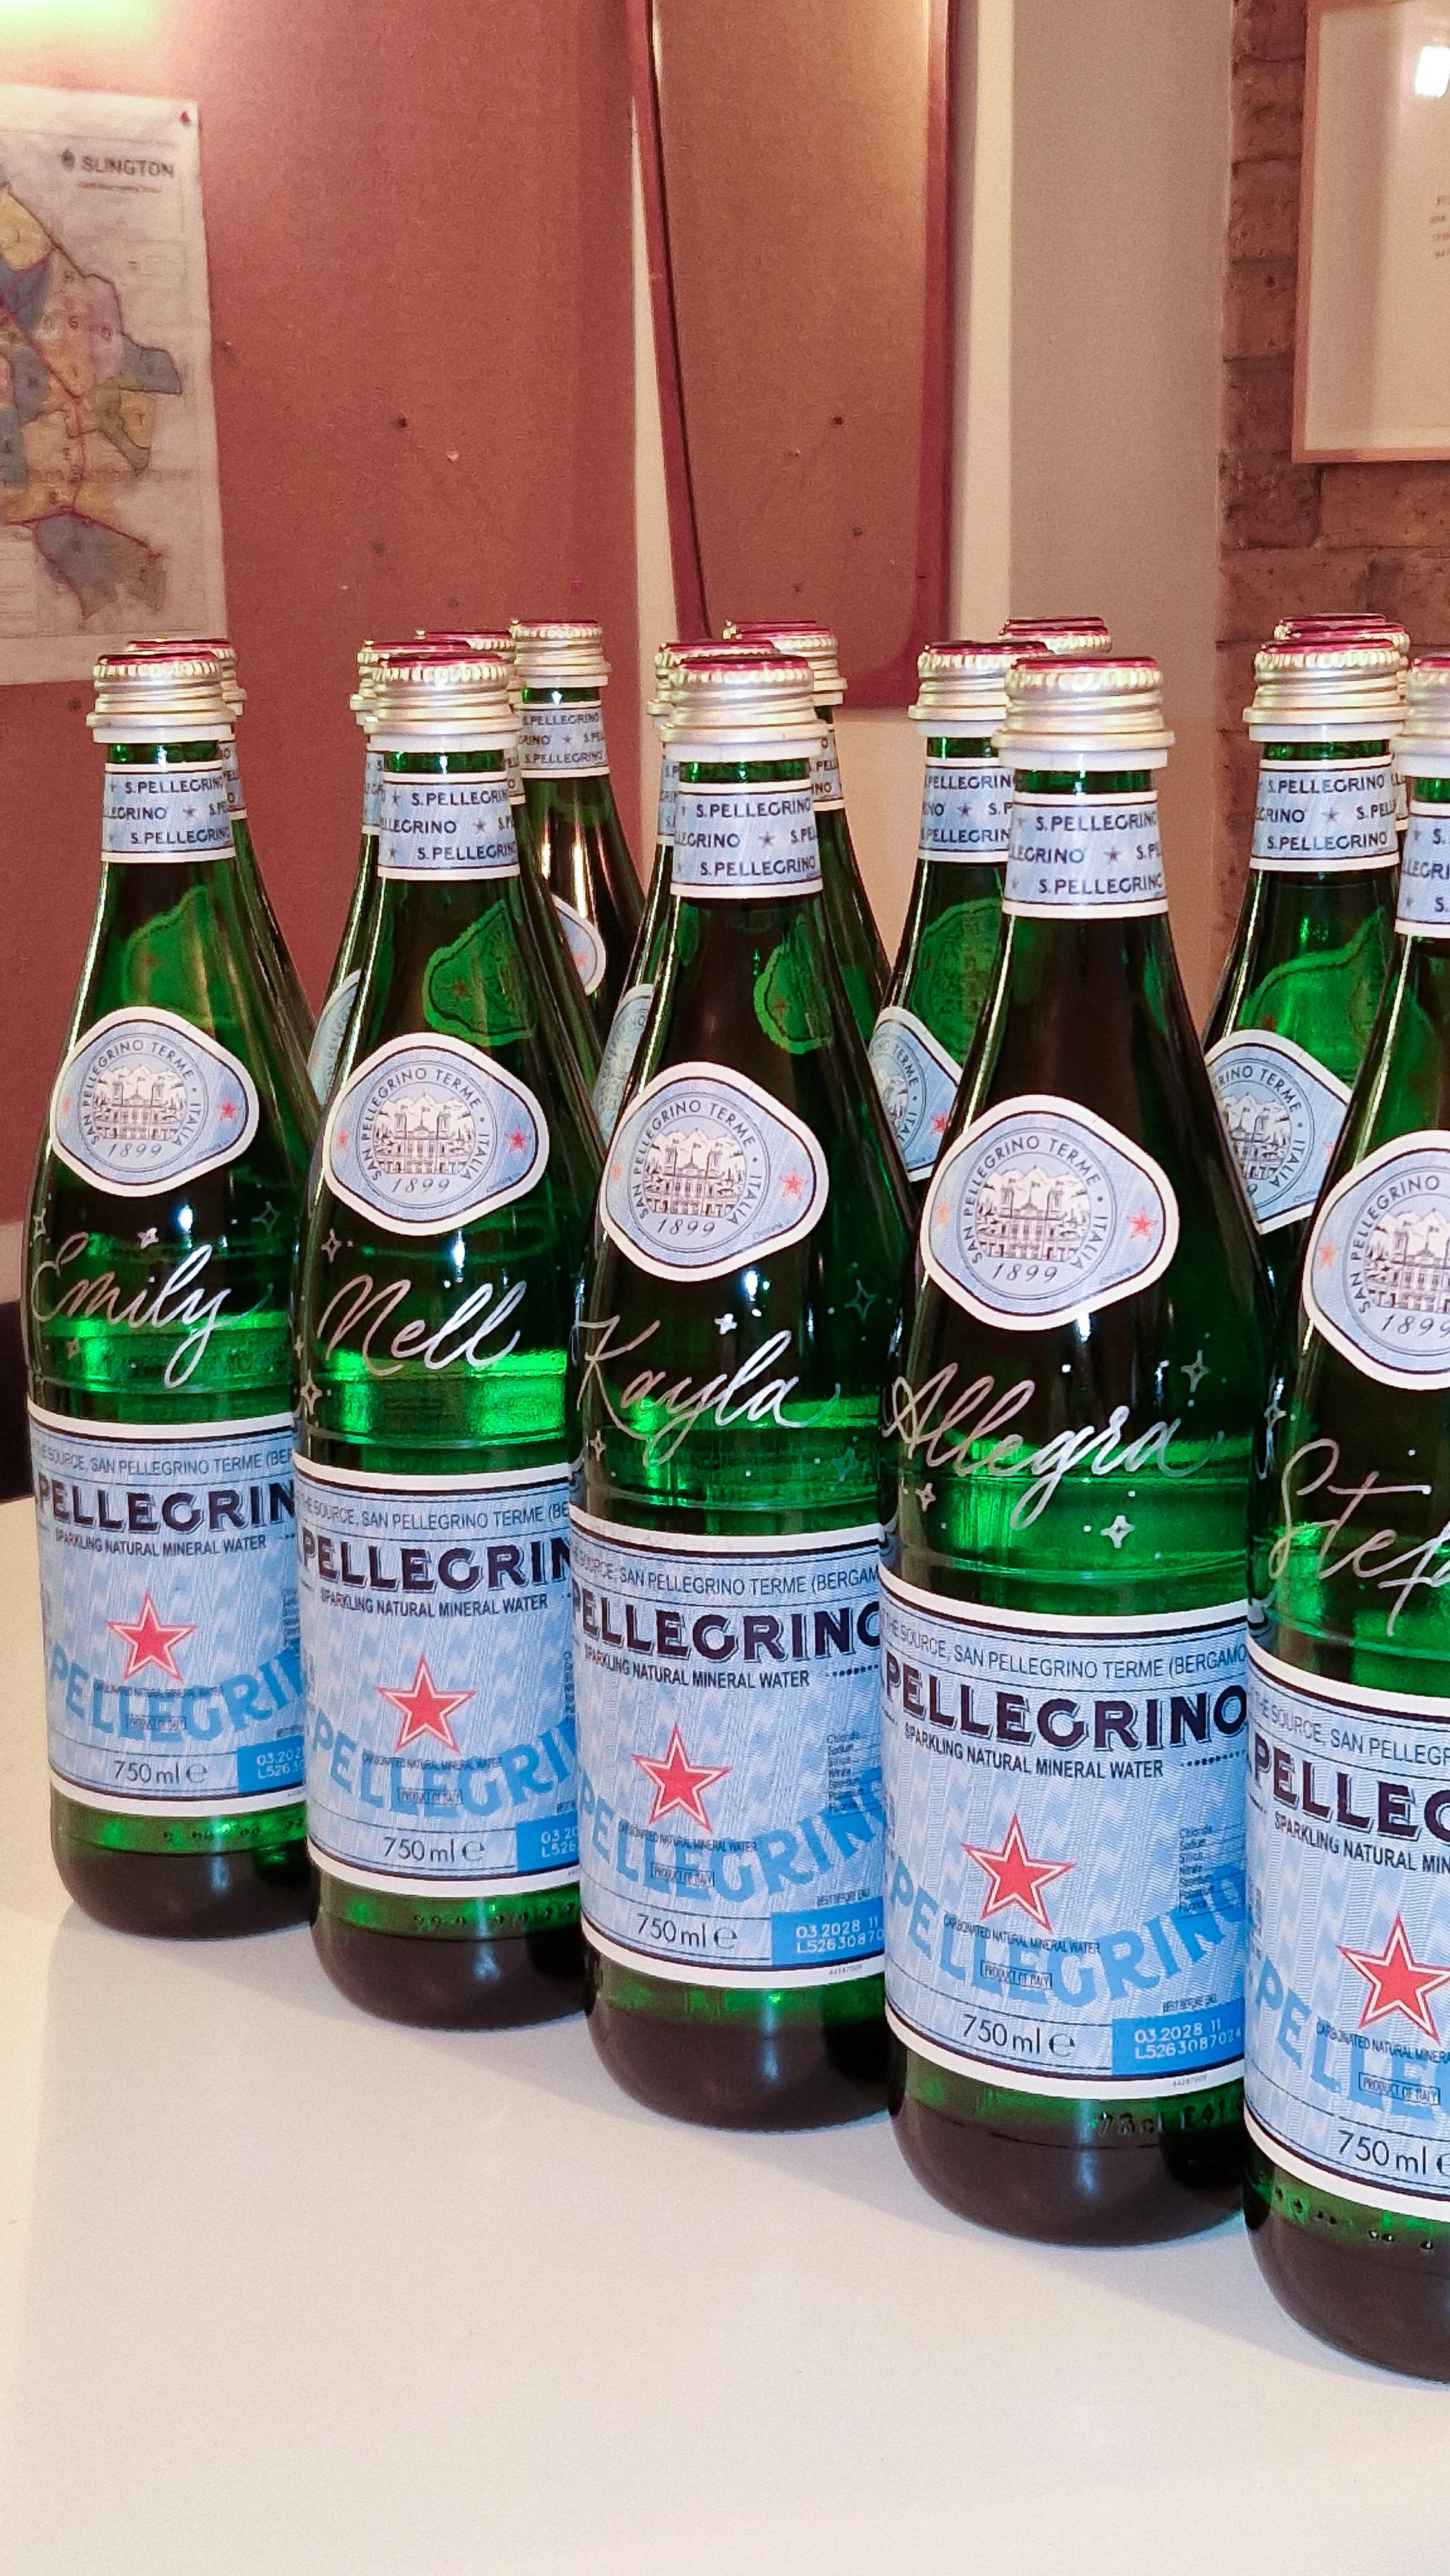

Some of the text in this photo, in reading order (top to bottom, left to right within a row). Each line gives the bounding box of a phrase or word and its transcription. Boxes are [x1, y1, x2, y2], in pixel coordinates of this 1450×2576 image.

[82, 1039, 144, 1107] PELLEGRINO
[151, 1041, 194, 1079] TERME
[173, 1103, 198, 1146] ITALIA
[1259, 1068, 1303, 1113] TERME
[361, 1067, 491, 1182] SAN PELLEGRINO TERME ITALIA
[108, 1142, 162, 1158] 1899
[632, 1099, 762, 1226] SAN PELLEGRINO TERME ITALIA
[1269, 1139, 1304, 1188] ITALIA
[391, 1178, 450, 1193] 1899
[963, 1135, 1109, 1270] SAN PELLEGRINO TERME ITALIA
[656, 1218, 715, 1237] 1899
[1350, 1175, 1440, 1314] SAN PELLEGRINO
[992, 1262, 1058, 1283] 1899
[31, 1231, 273, 1388] Emily
[317, 1274, 527, 1377] Nell
[570, 1314, 841, 1467] Kayla
[882, 1361, 1225, 1530] Allegra
[118, 1459, 210, 1475] PELLEGRINO
[214, 1453, 261, 1473] TERME
[392, 1511, 489, 1531] PELLEGRINO
[494, 1505, 544, 1528] TERME
[105, 1537, 160, 1557] NATURAL
[163, 1537, 220, 1557] MINERAL
[223, 1534, 267, 1553] WATER
[647, 1571, 746, 1596] PELLEGRINO
[751, 1576, 807, 1596] TERME
[376, 1597, 433, 1618] NATURAL
[438, 1596, 500, 1619] MINERAL
[502, 1593, 548, 1615] WATER
[632, 1660, 690, 1687] NATURAL
[692, 1669, 756, 1689] MINERAL
[759, 1669, 810, 1689] WATER
[954, 1643, 985, 1669] SAN
[988, 1650, 1098, 1680] PELLEGRINO
[1104, 1656, 1163, 1680] TERME
[1330, 1728, 1364, 1754] SAN
[966, 1745, 1031, 1776] NATURAL
[1035, 1758, 1106, 1781] MINERAL
[1109, 1758, 1165, 1780] WATER
[1275, 1811, 1340, 1855] SPARKLING
[1343, 1838, 1417, 1872] NATURAL
[795, 1918, 861, 1940] 03.2028
